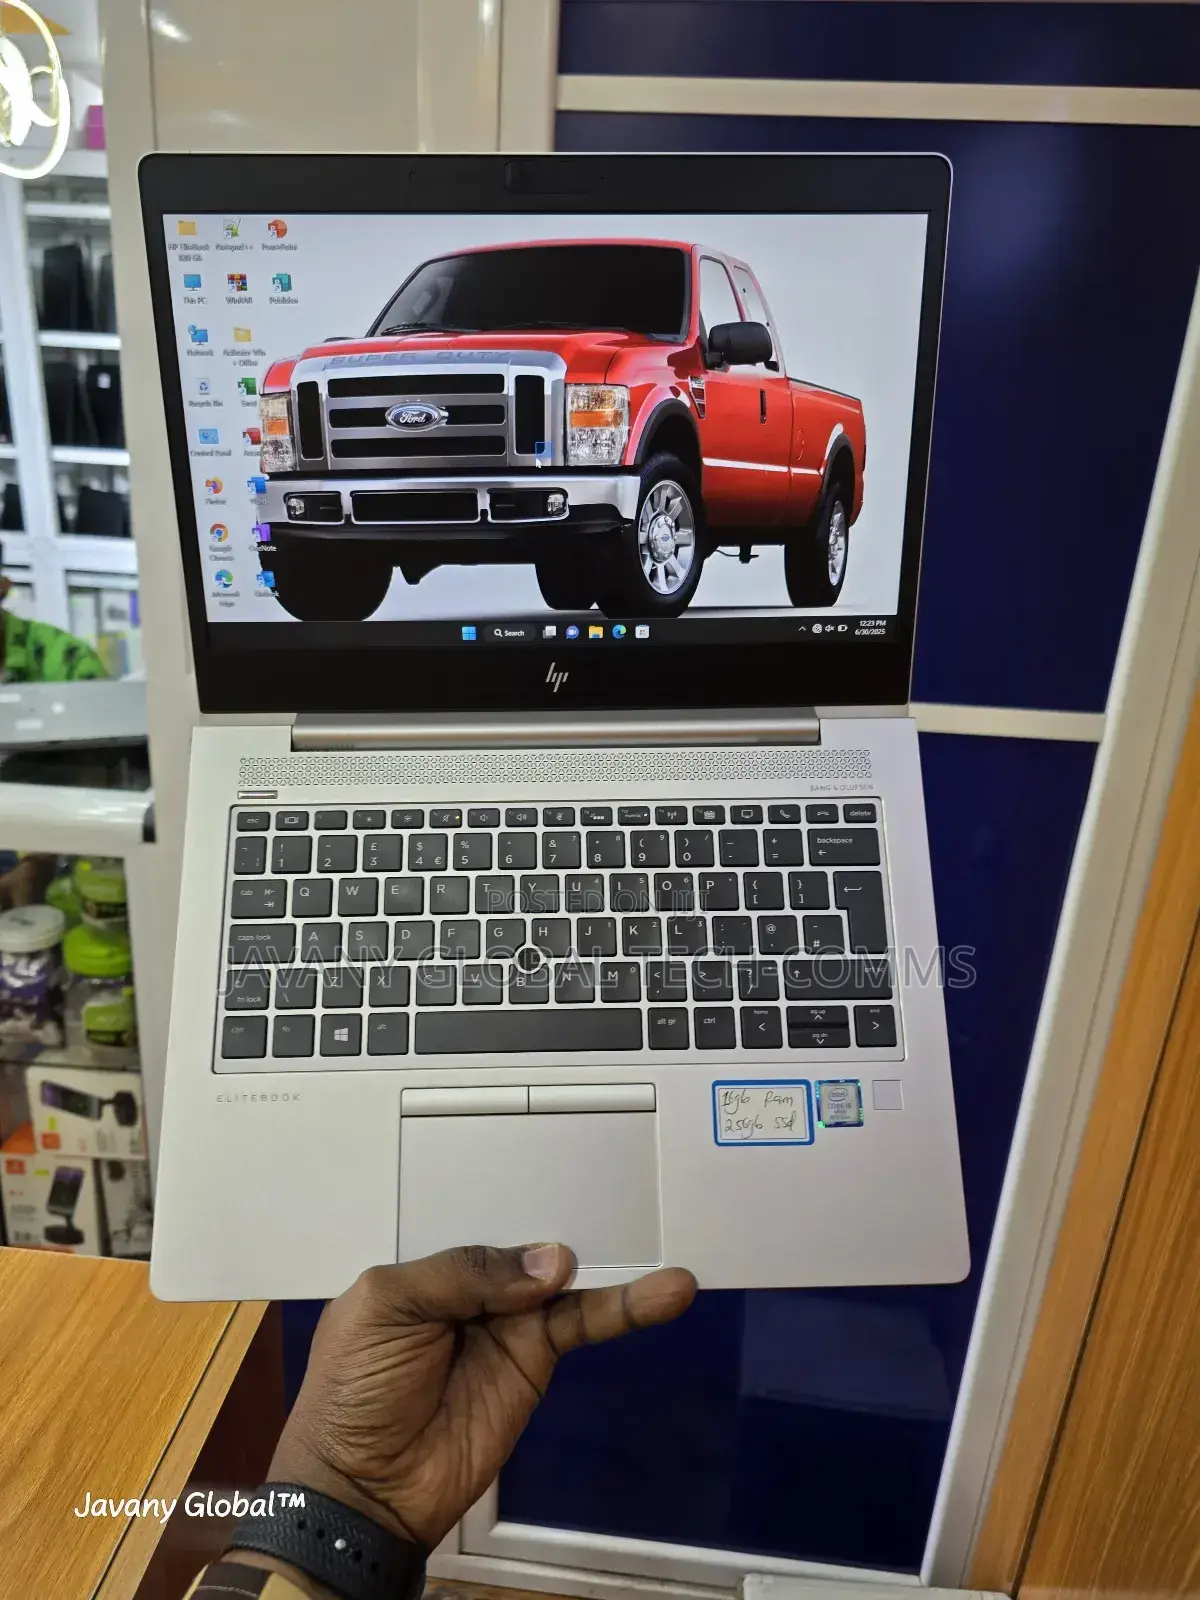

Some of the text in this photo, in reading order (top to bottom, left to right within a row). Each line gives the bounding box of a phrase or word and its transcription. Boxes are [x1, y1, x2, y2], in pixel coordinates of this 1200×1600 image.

[269, 296, 299, 304] Publisher
[399, 411, 426, 424] Ford
[504, 629, 525, 638] Search
[854, 628, 886, 636] 6/30/2025
[546, 662, 569, 692] hp
[810, 784, 832, 792] BANG
[817, 837, 854, 846] backspace
[417, 842, 423, 851] $
[415, 857, 422, 865] 4
[462, 856, 468, 864] 5
[506, 855, 512, 863] 6
[594, 854, 601, 862] 8
[639, 853, 646, 861] 9
[325, 858, 331, 866] 2
[370, 857, 378, 867] 3
[392, 885, 399, 894] E
[437, 885, 445, 893] R
[483, 884, 491, 893] T
[528, 883, 537, 893] Y
[572, 882, 581, 891] U
[662, 881, 672, 891] O
[707, 881, 715, 890] P
[300, 887, 309, 896] Q
[346, 886, 359, 895] W
[448, 929, 455, 937] F
[494, 928, 503, 937] G
[539, 927, 547, 936] H
[585, 926, 591, 935] J
[630, 926, 638, 934] K
[675, 925, 682, 934] L
[766, 924, 776, 934] @
[309, 932, 318, 941] A
[356, 931, 363, 940] S
[402, 930, 411, 939] D
[812, 940, 821, 948] #
[704, 1017, 716, 1025] ctrl
[216, 1093, 301, 1103] ELITEBOOK
